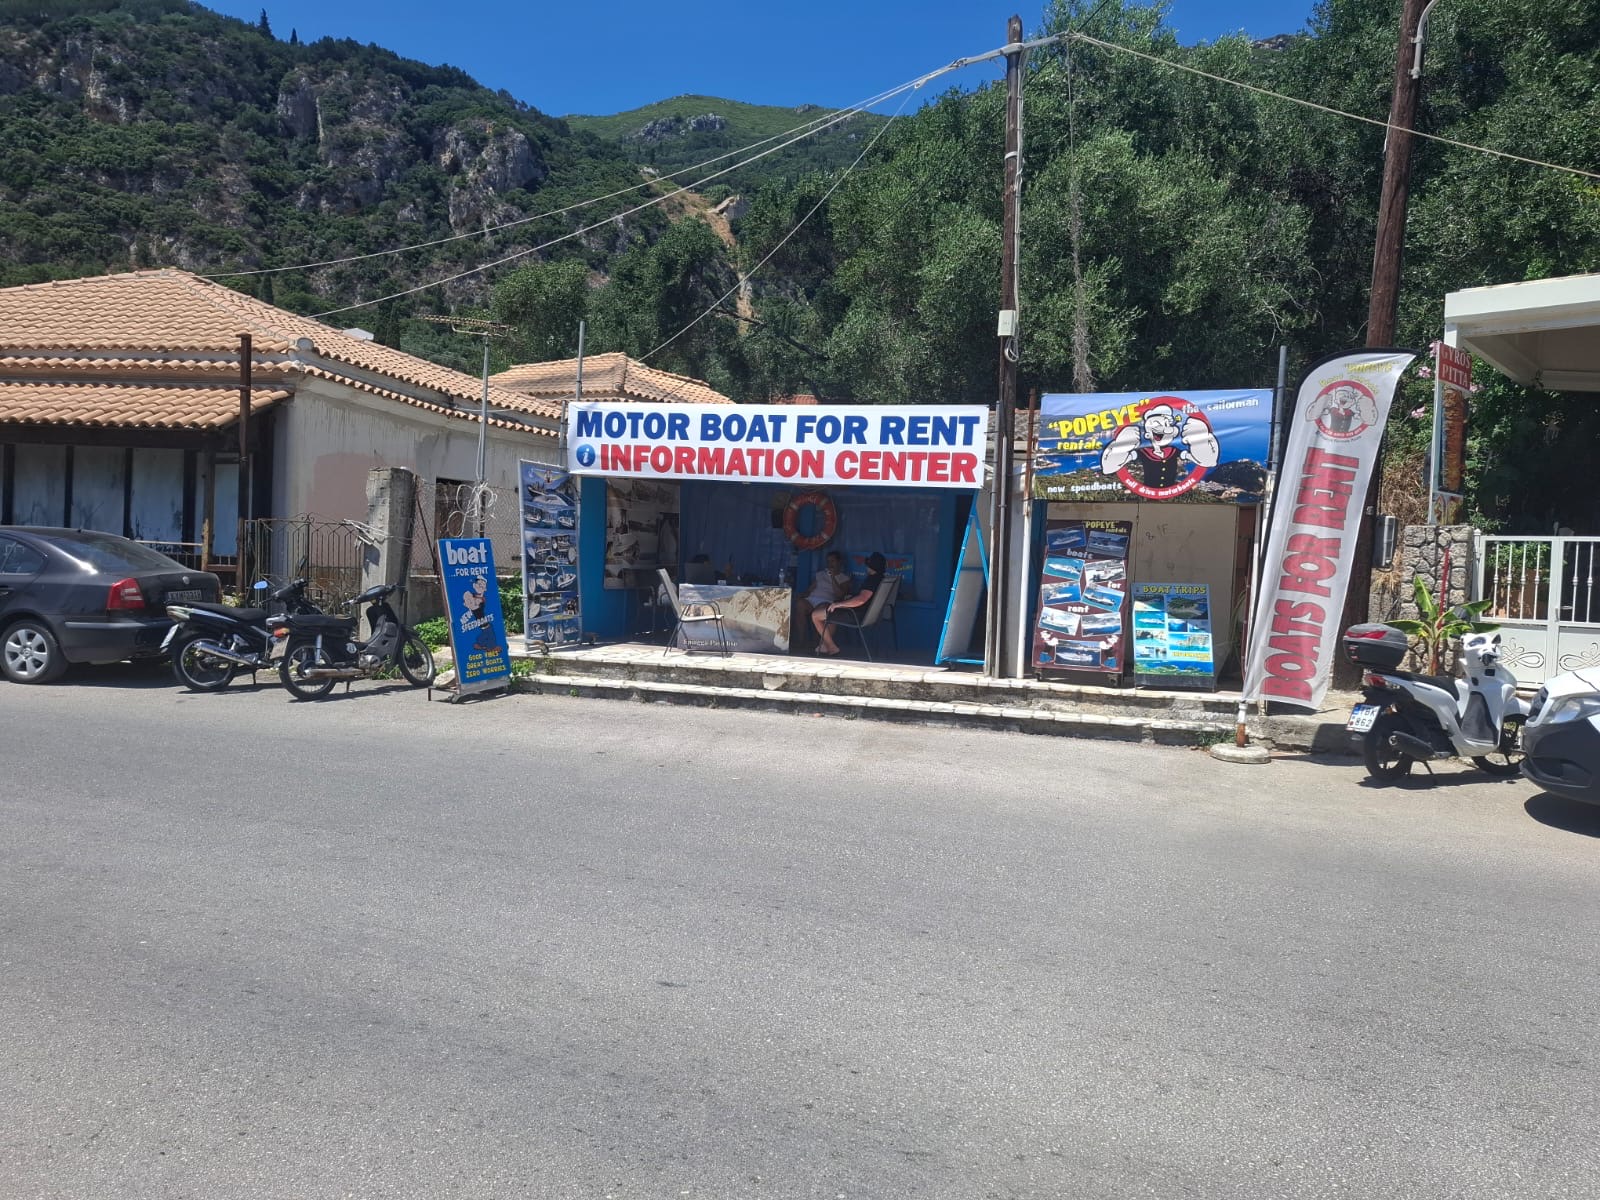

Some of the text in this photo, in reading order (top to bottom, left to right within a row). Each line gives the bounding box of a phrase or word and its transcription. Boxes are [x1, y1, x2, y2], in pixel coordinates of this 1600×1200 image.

[1441, 345, 1470, 369] GYROS
[1442, 363, 1468, 387] PITTA
[1182, 398, 1259, 414] the sailorman
[577, 410, 980, 446] MOTOR BOAT FOR RENT
[1057, 438, 1103, 450] rentals
[600, 443, 825, 478] INFORMATION
[835, 450, 977, 483] CENTER
[1047, 481, 1123, 494] new speedboats
[1292, 446, 1360, 531] RENT
[445, 540, 488, 565] boat
[1066, 548, 1094, 559] boats
[470, 566, 489, 576] RENT
[1279, 533, 1342, 598] FOR
[1107, 581, 1122, 589] for
[1143, 585, 1207, 595] BOAT TRIPS
[1067, 605, 1090, 613] rent
[1259, 599, 1326, 702] BOATS
